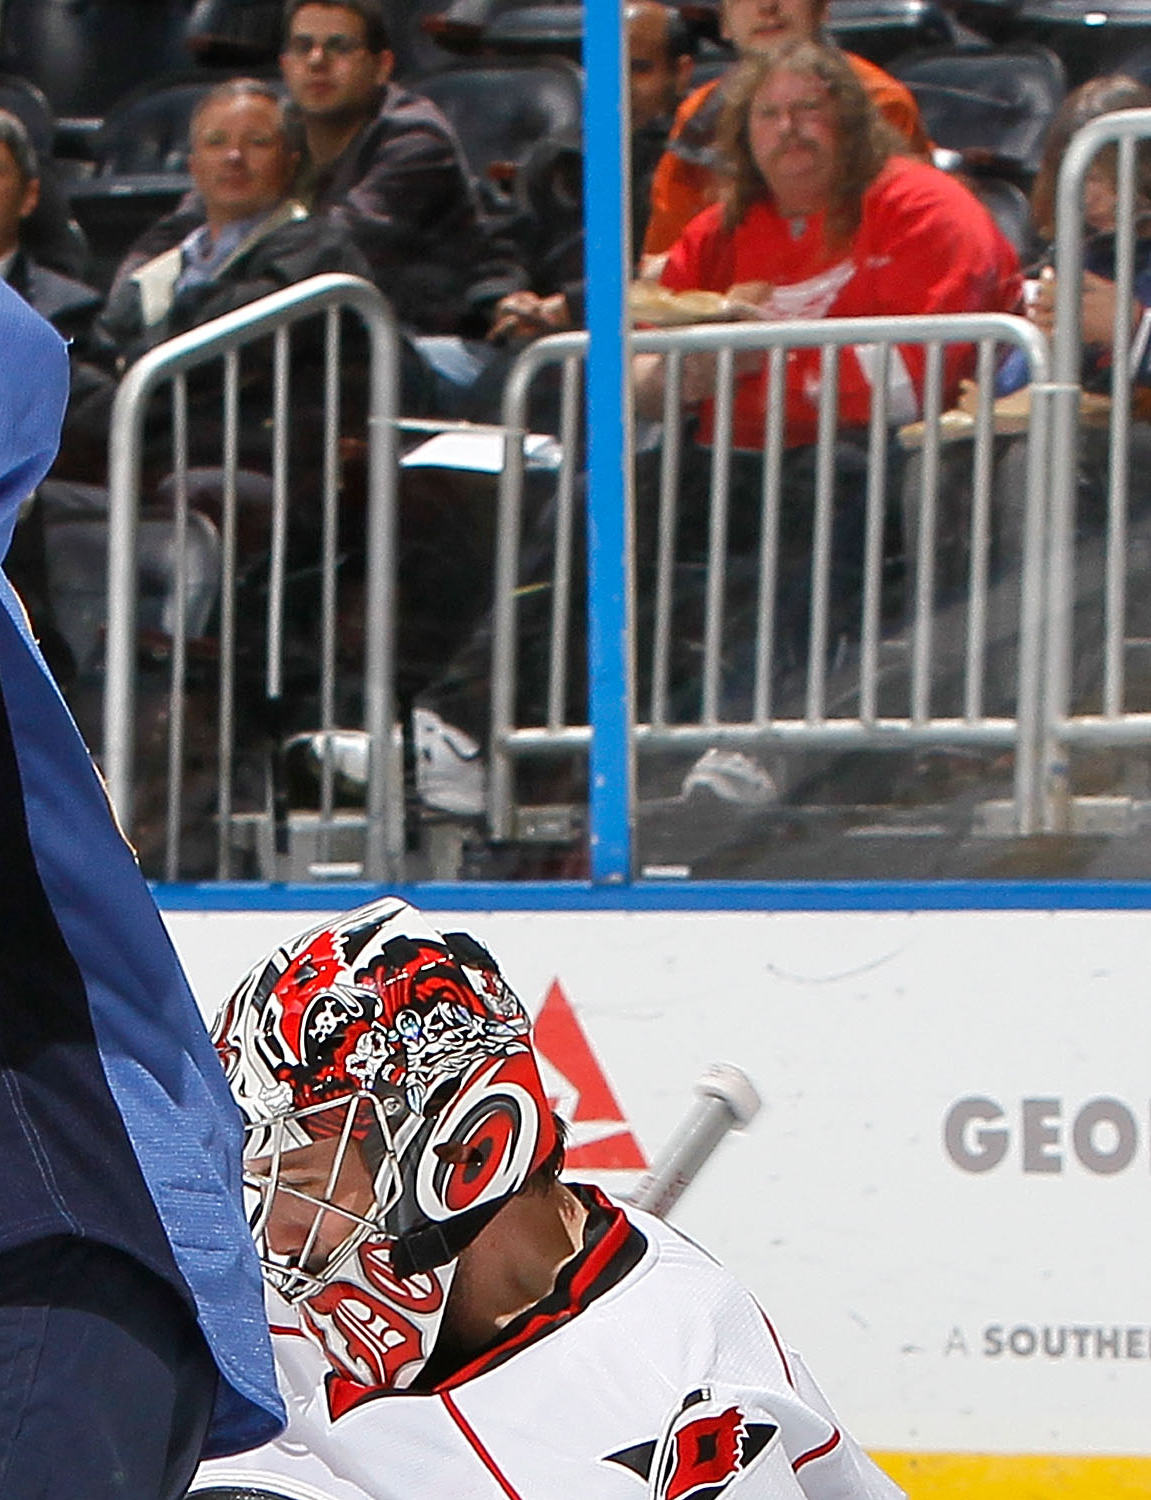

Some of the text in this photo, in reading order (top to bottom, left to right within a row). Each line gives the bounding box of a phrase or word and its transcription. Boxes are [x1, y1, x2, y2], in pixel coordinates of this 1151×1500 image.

[944, 1096, 1151, 1175] GEO
[946, 1324, 1151, 1360] A SOUTHE
